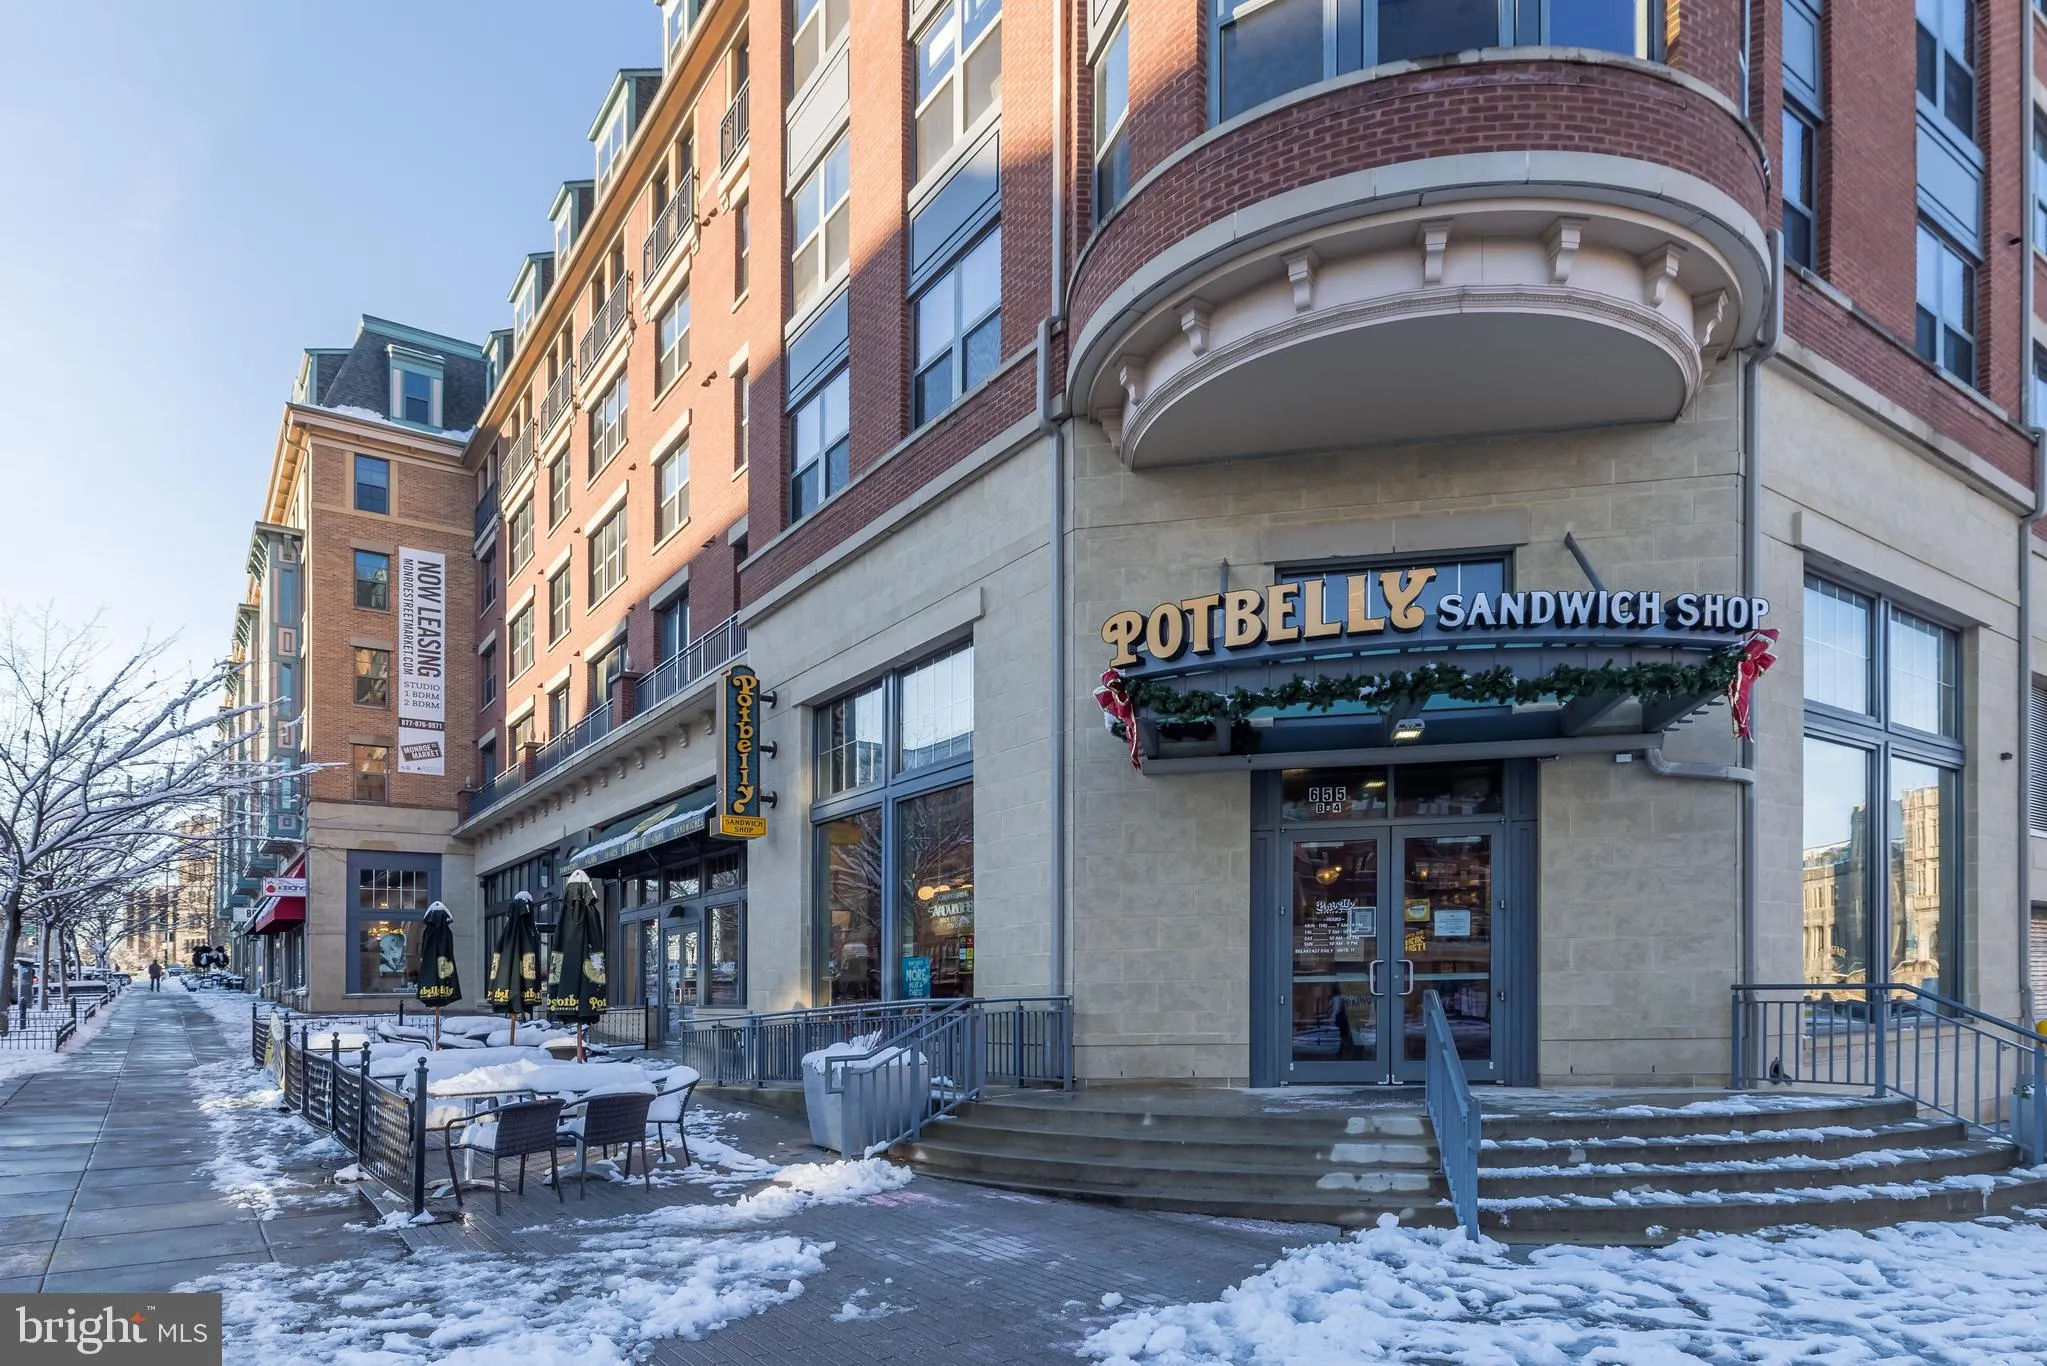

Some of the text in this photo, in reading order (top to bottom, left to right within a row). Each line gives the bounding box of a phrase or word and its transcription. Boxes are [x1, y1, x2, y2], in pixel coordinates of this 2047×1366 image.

[403, 558, 414, 675] MONROESTREETMARKET.COM
[417, 560, 442, 678] NOW LEASING
[1101, 567, 1770, 668] POTBELLY SANDWICH SHOP
[403, 681, 440, 691] STUDIO
[412, 691, 440, 701] BDRM
[412, 700, 440, 709] BDRM
[403, 744, 432, 754] MONROE
[732, 675, 757, 814] Potbelly
[412, 750, 440, 759] MARKET
[1309, 787, 1346, 802] 655
[673, 817, 704, 836] SANDWICHES
[725, 818, 763, 829] SANDWICH
[734, 826, 754, 834] SHOP
[905, 968, 926, 981] MORE
